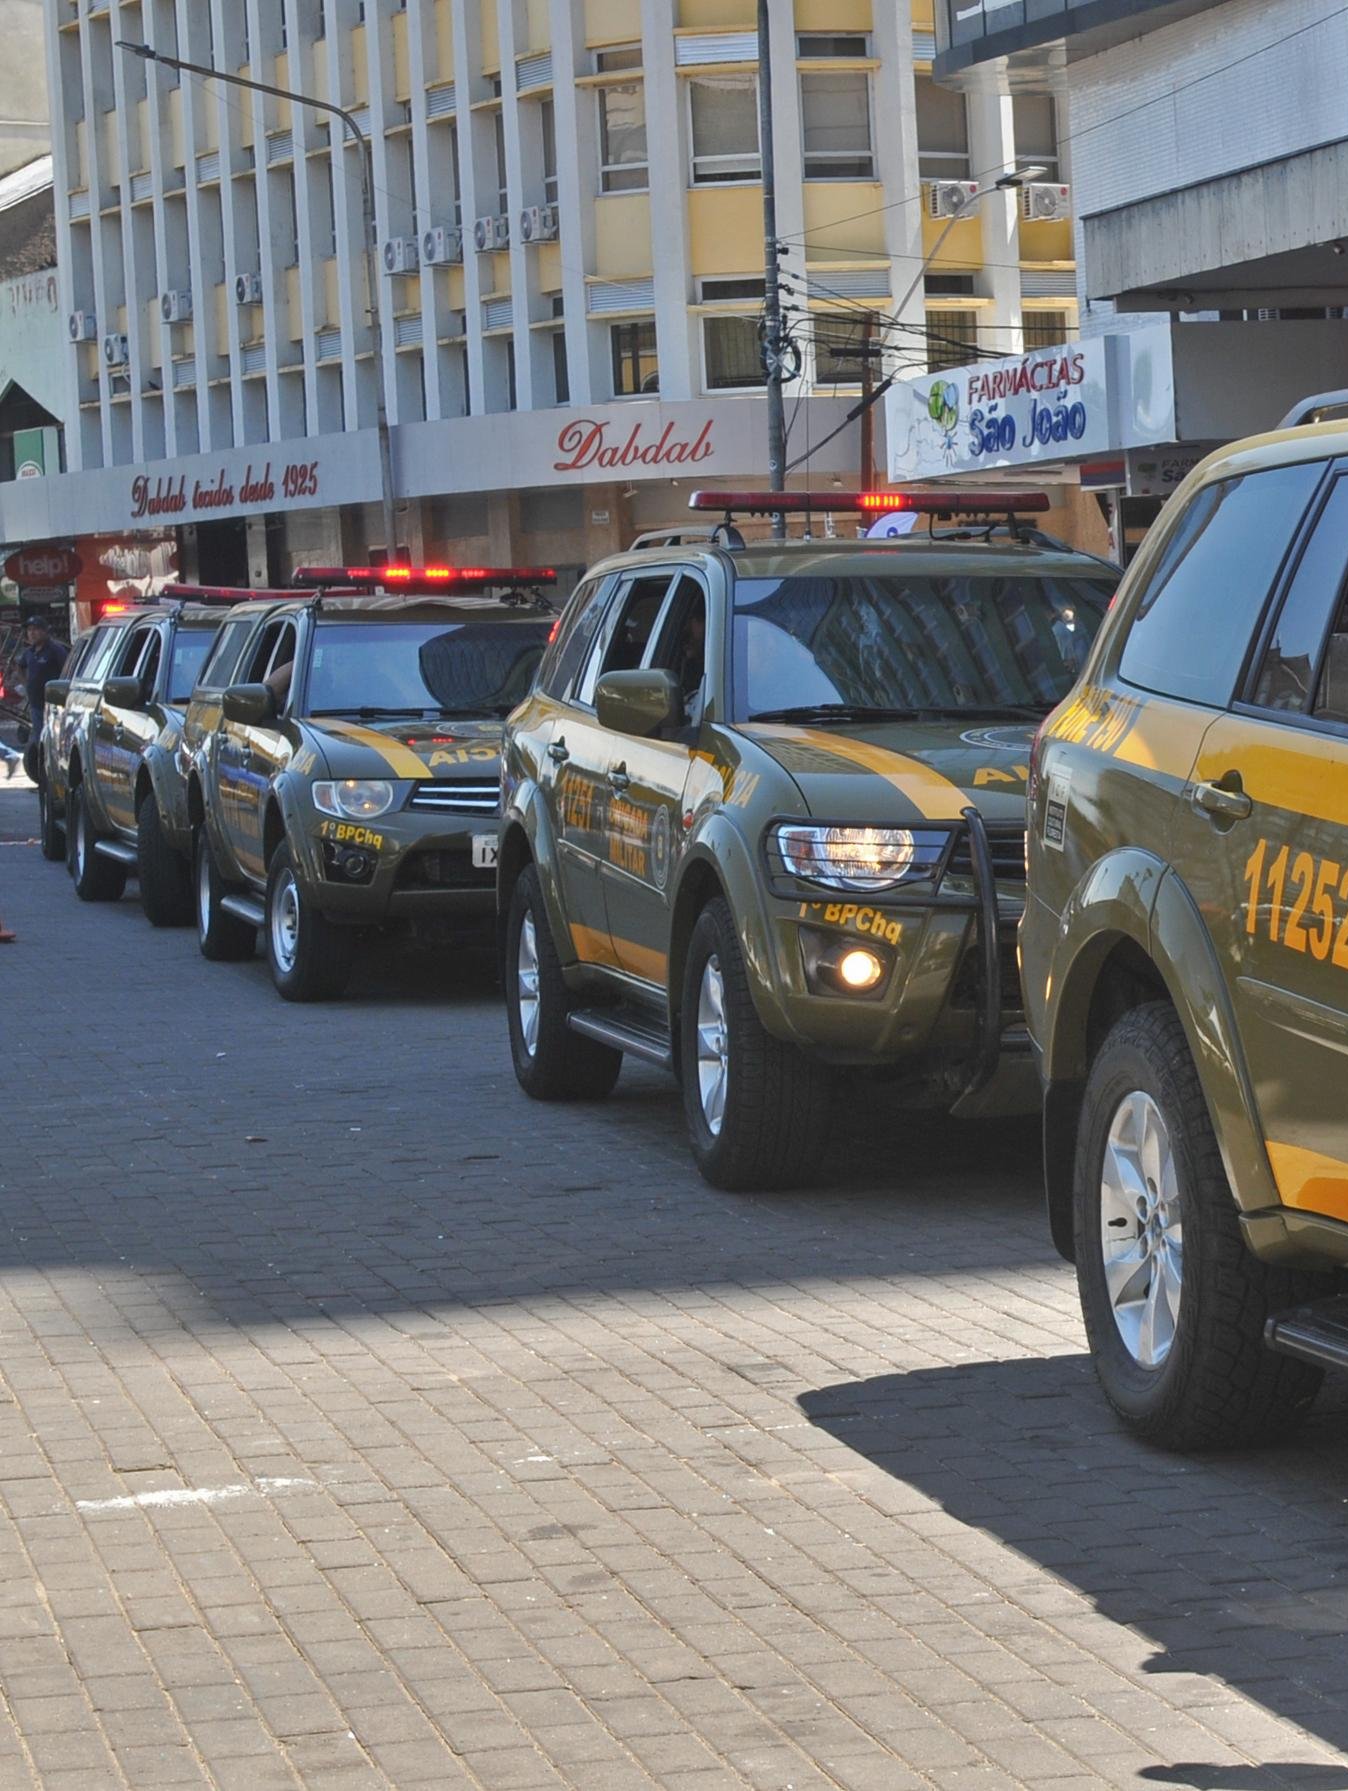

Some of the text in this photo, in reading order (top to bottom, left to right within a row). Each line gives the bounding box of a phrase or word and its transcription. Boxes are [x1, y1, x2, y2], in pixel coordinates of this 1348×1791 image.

[968, 353, 1085, 405] FARMÁCIAS
[553, 419, 715, 471] Dabdab
[968, 388, 1086, 457] São João
[131, 461, 319, 518] Dabdab tecidos desde 1925
[19, 556, 69, 579] help!
[336, 823, 383, 850] BPChq
[823, 903, 903, 945] BPChq
